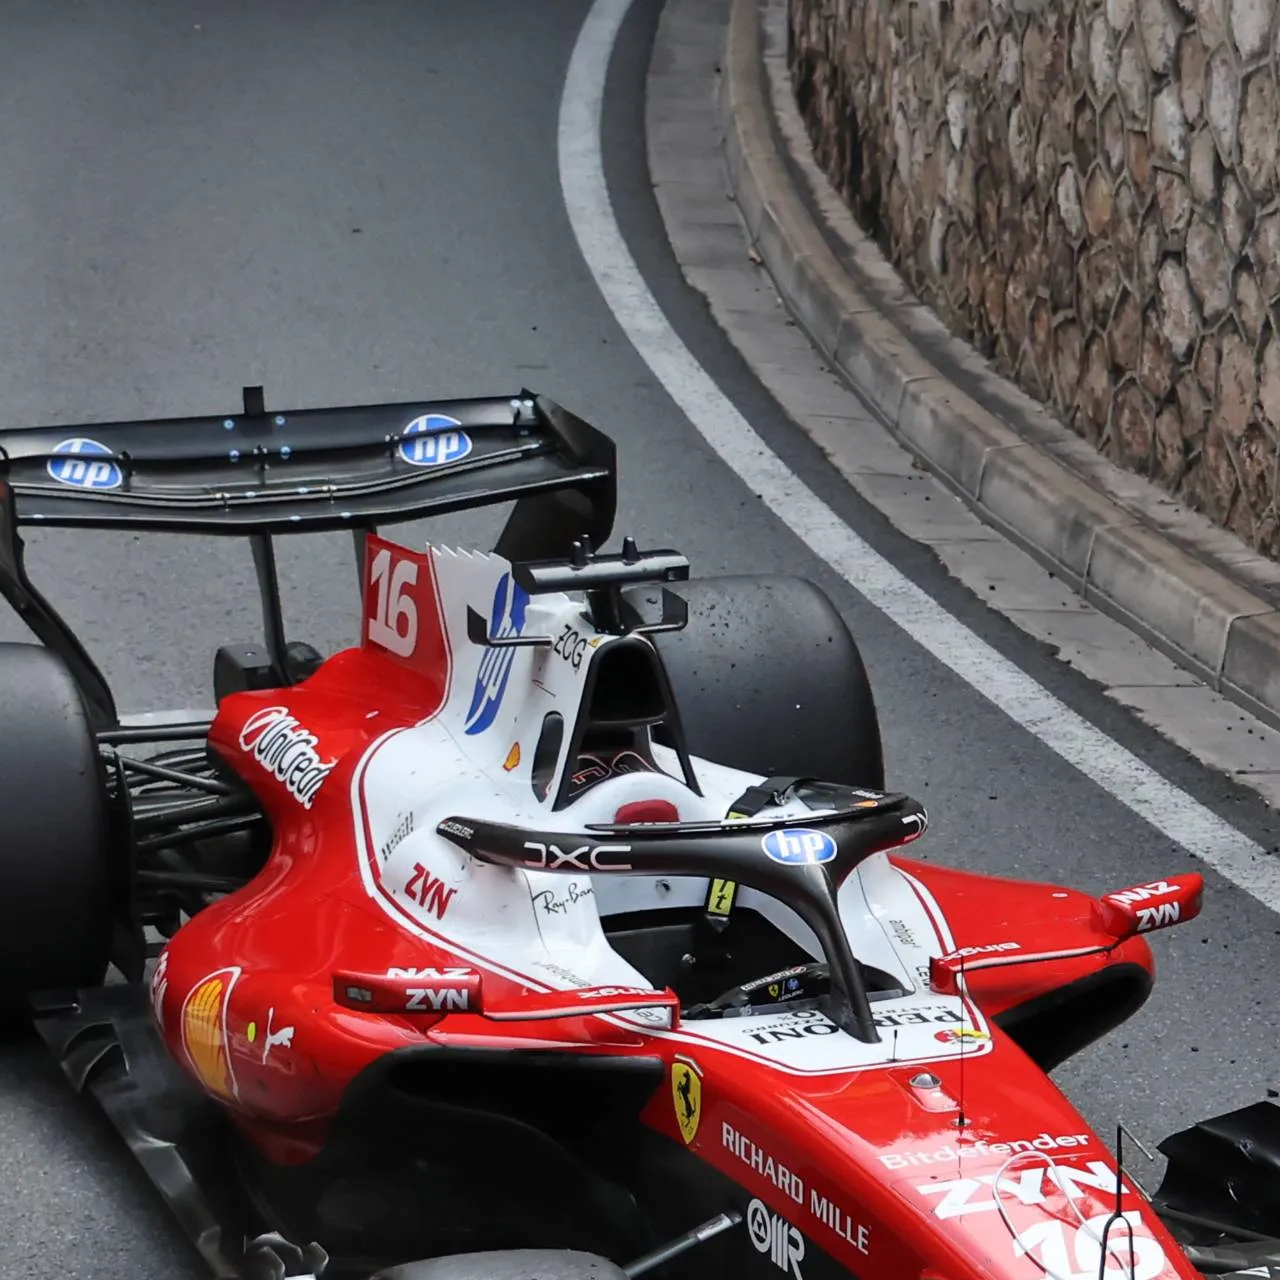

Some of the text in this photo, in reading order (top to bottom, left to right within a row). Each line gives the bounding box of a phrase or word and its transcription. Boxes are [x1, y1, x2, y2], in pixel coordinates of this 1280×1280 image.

[369, 548, 419, 658] 16
[524, 842, 632, 870] DXC
[772, 830, 830, 864] hp
[405, 862, 457, 920] ZYN
[1135, 901, 1181, 932] ZYN
[406, 988, 468, 1010] ZYN
[879, 1132, 1090, 1170] Bitdefender
[722, 1120, 870, 1256] RICHARD MILLE
[916, 1160, 1130, 1220] ZYN
